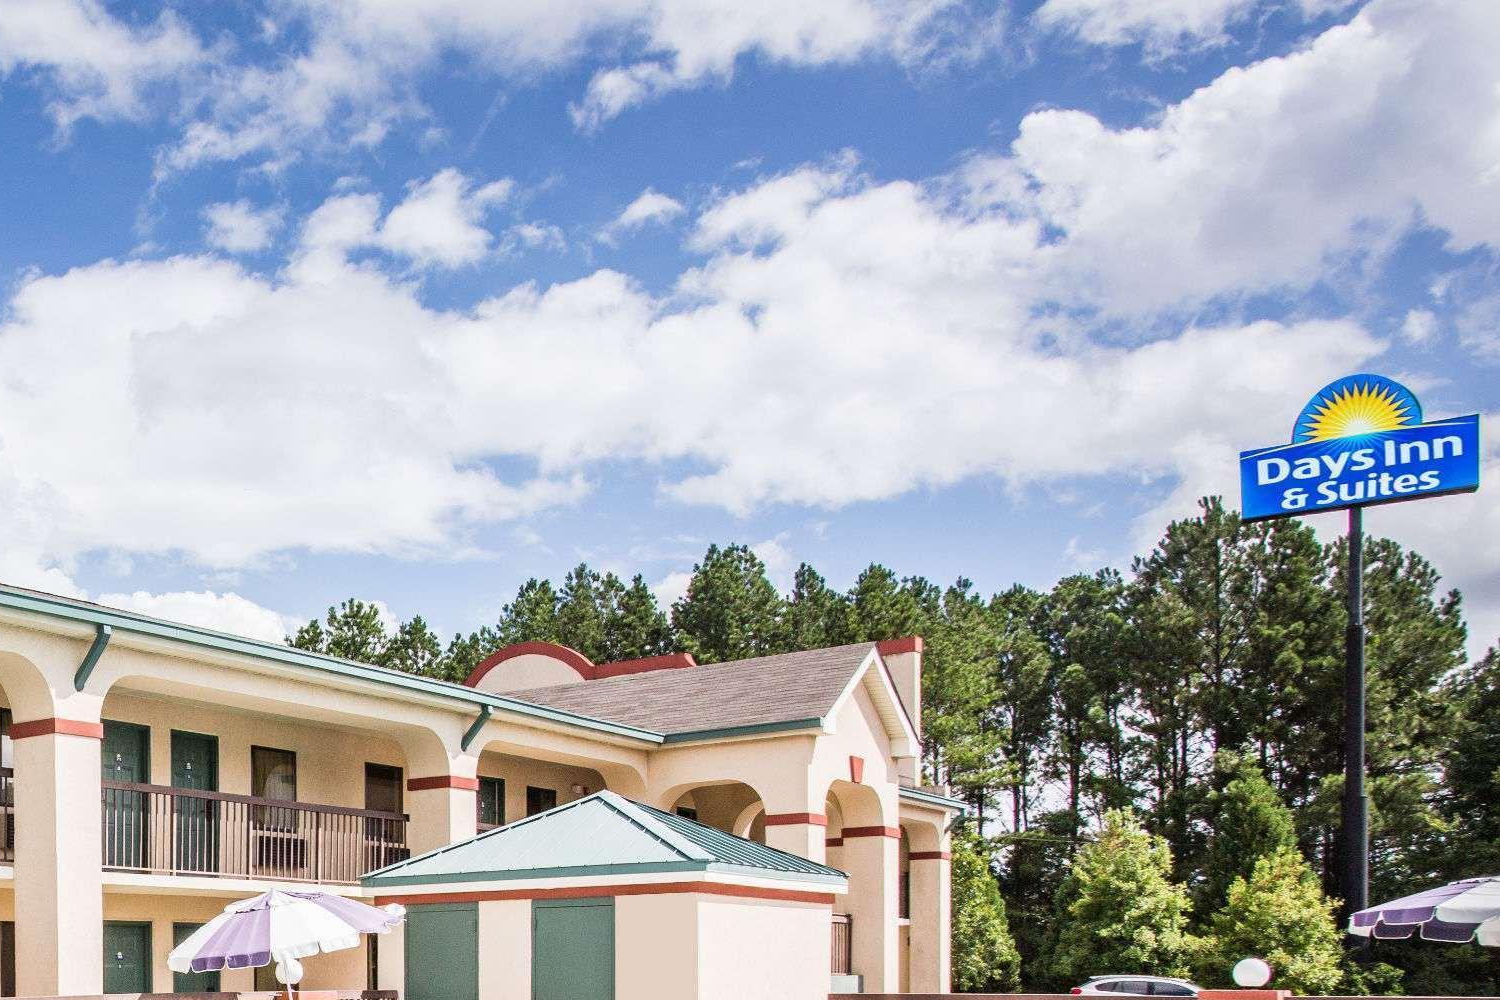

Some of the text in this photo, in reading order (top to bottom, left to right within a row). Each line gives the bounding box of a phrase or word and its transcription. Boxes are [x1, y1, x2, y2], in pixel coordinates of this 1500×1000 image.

[1257, 435, 1463, 486] Days Inn
[1281, 470, 1441, 510] & Suites
